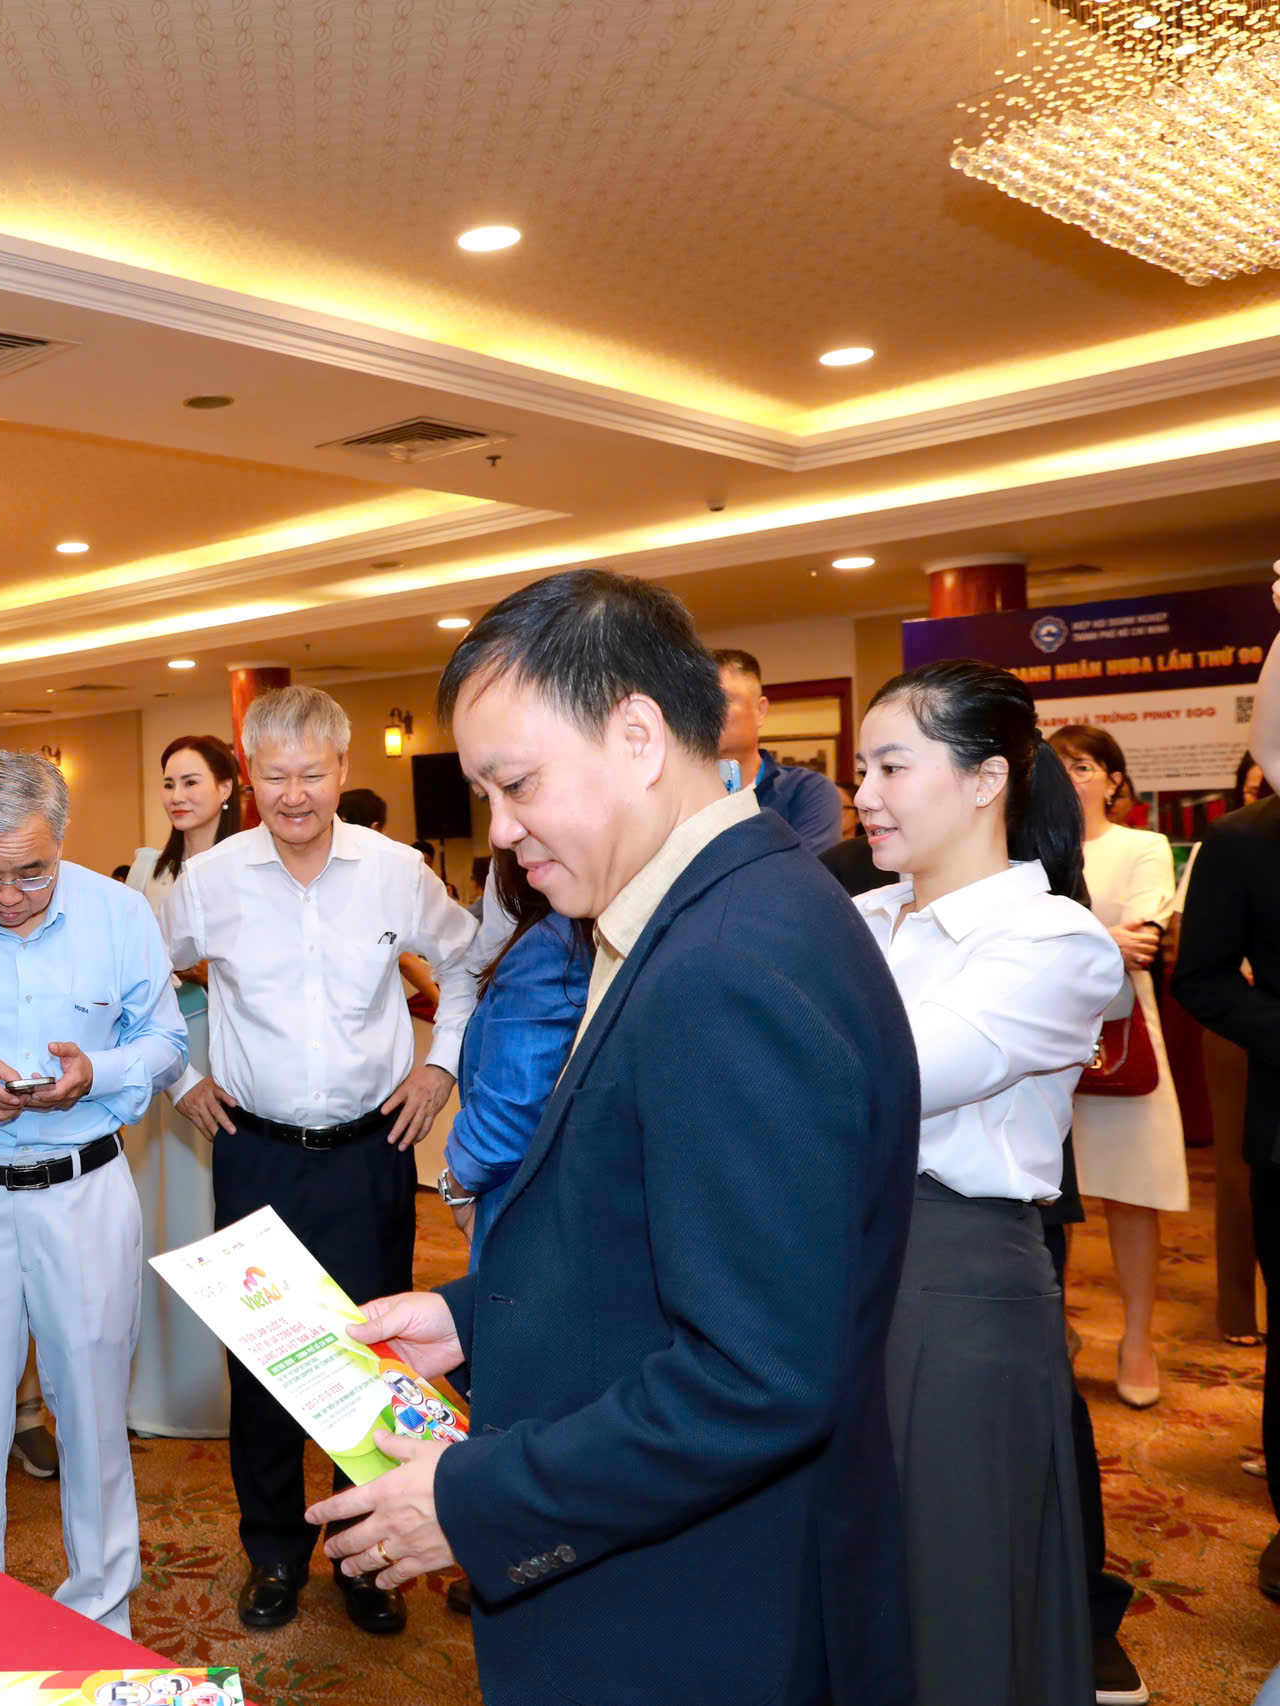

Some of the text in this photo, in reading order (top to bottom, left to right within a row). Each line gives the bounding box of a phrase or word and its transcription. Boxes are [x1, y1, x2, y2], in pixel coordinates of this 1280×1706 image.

[1055, 658, 1103, 681] NHÂN
[1106, 655, 1154, 677] HUBA
[1197, 644, 1236, 669] THỨ
[1238, 646, 1263, 665] 90
[1186, 706, 1217, 719] EGG
